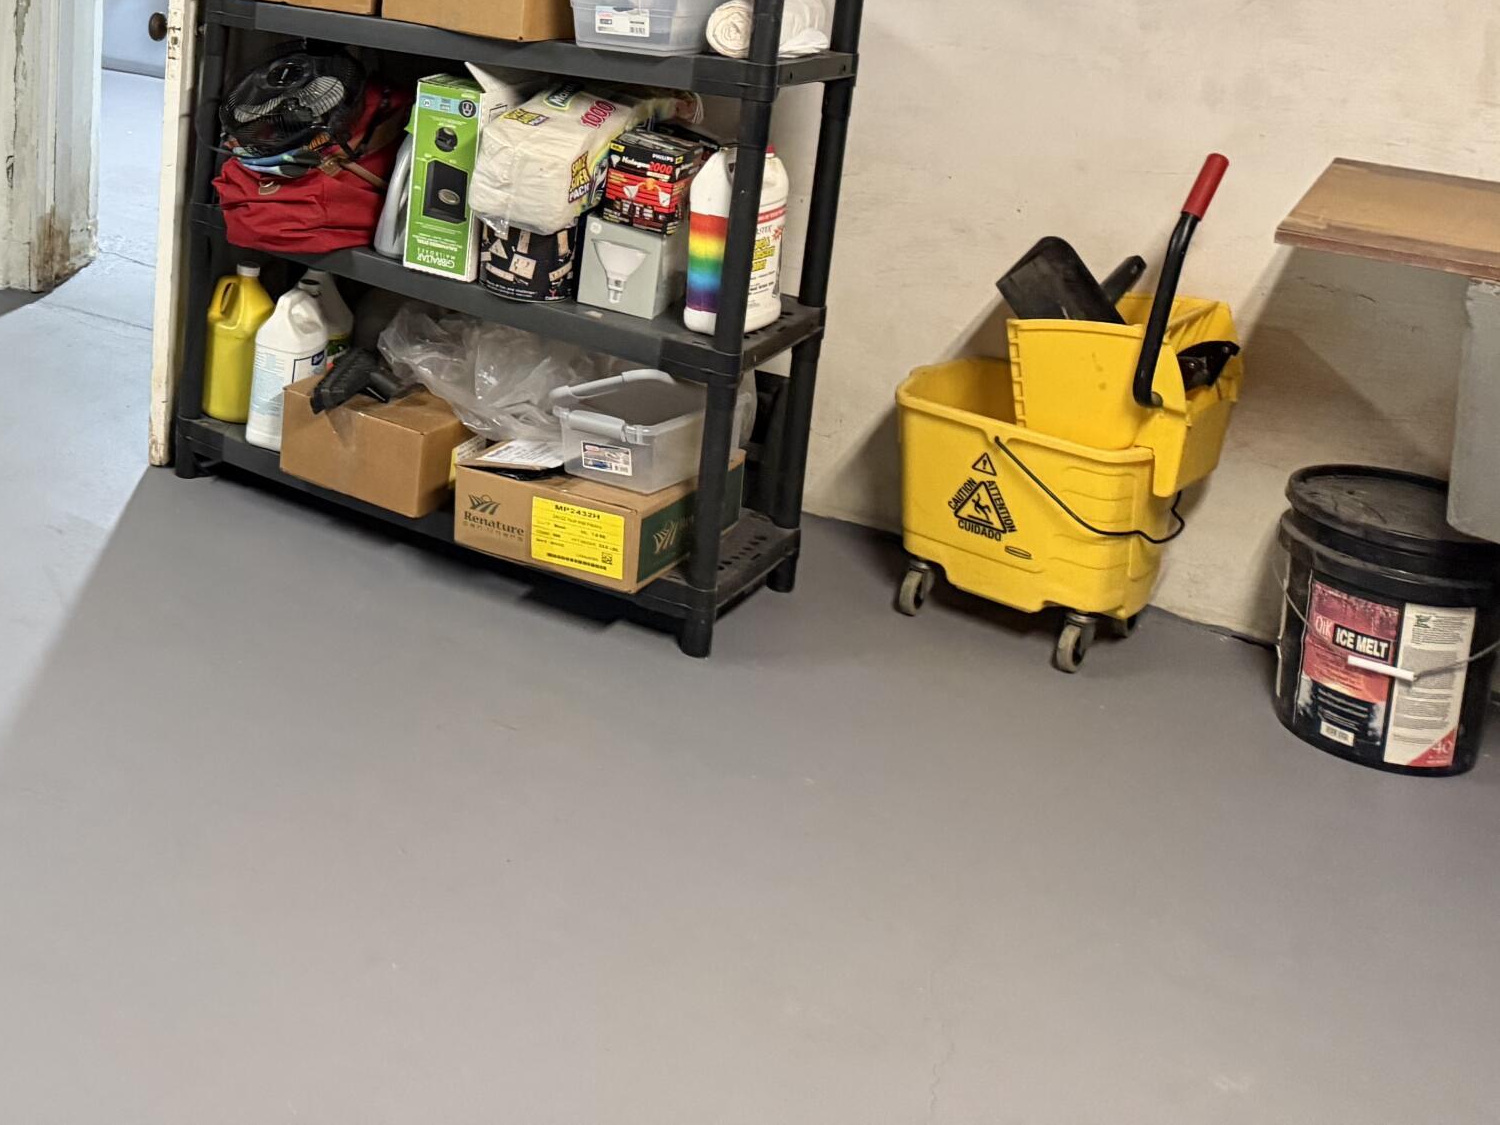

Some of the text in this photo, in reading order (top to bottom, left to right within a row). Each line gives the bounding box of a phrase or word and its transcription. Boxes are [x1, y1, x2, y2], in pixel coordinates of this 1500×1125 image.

[581, 100, 615, 129] 1000
[649, 161, 673, 175] 2000
[652, 153, 674, 163] PHILIPS
[570, 183, 590, 202] PACK
[417, 253, 455, 269] GIBRALTAR
[948, 477, 977, 510] CAUTION
[986, 480, 1018, 533] ATTENTION
[464, 511, 525, 536] Renature
[958, 519, 1002, 542] CUIDADO
[1335, 627, 1388, 659] ICE MELT
